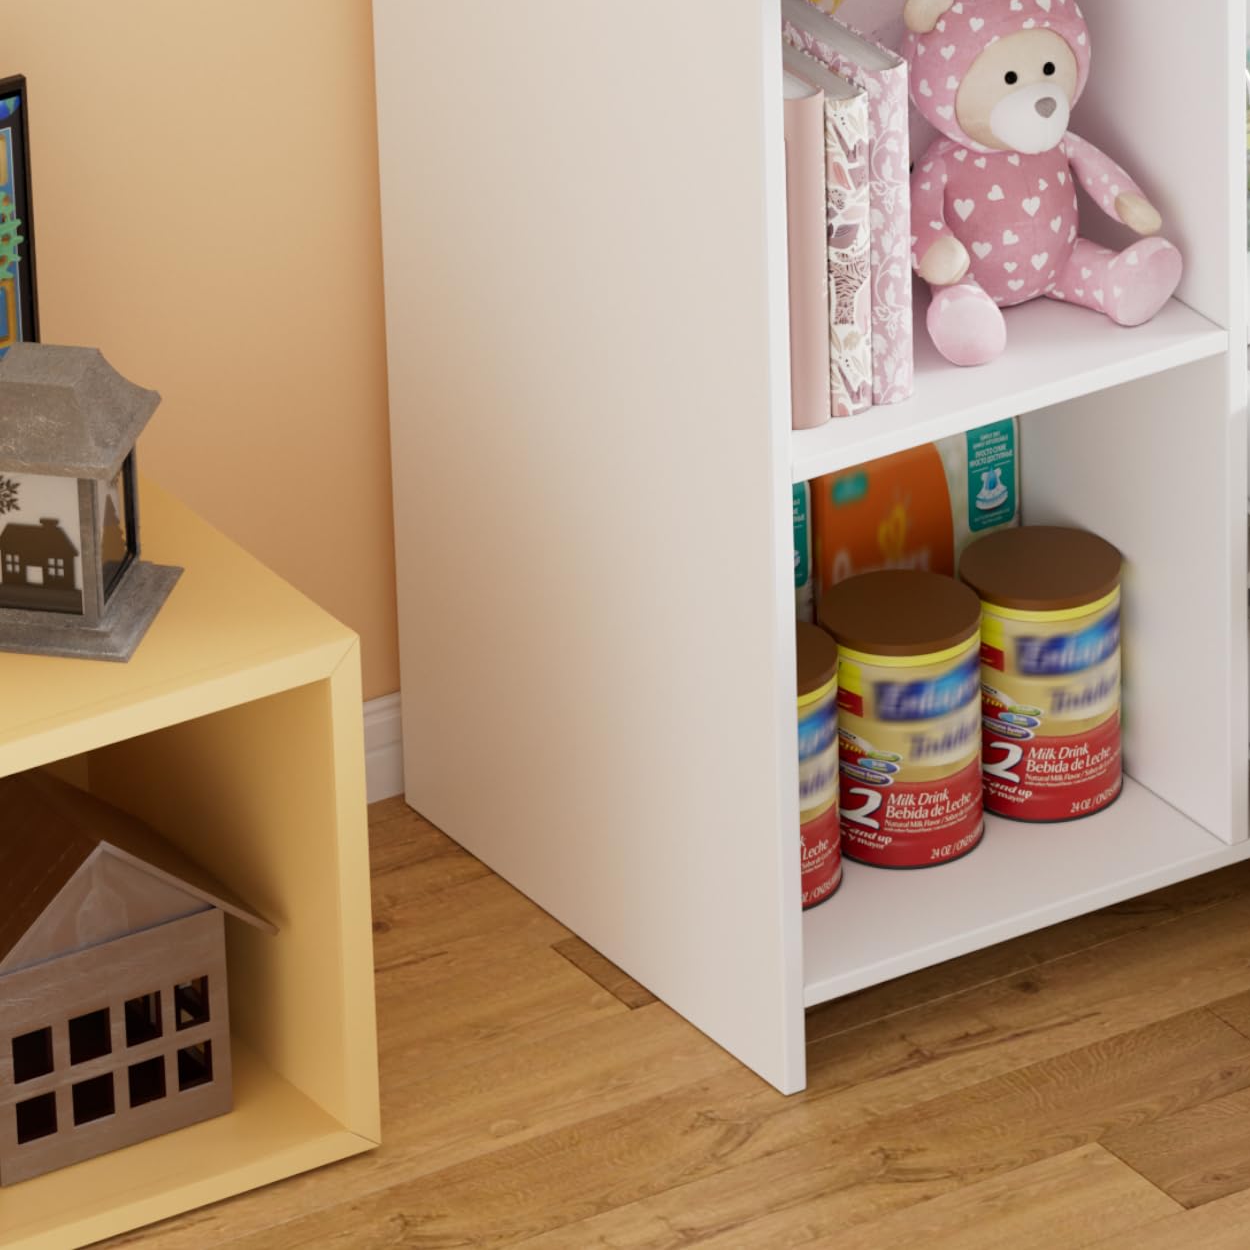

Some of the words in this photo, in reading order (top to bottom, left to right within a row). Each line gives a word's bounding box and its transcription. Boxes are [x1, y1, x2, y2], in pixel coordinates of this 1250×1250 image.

[1028, 746, 1057, 760] Milk
[1058, 742, 1089, 760] Drink
[983, 741, 1023, 783] 2
[1026, 759, 1069, 774] Bebida
[1070, 757, 1085, 771] de
[1085, 746, 1111, 768] Leche
[1024, 773, 1050, 781] Natural
[1050, 773, 1064, 782] Milk
[887, 792, 916, 806] Milk
[918, 787, 949, 806] Drink
[997, 791, 1025, 804] mayor
[1018, 789, 1033, 799] up
[840, 787, 882, 830] 2
[886, 805, 929, 819] Bebida
[930, 803, 945, 817] de
[945, 792, 972, 814] Leche
[1070, 801, 1080, 813] 24
[1080, 798, 1092, 810] OZ
[884, 819, 910, 828] Natural
[910, 819, 924, 828] Milk
[857, 837, 885, 850] mayor
[877, 835, 893, 845] up
[803, 838, 829, 860] Leche
[930, 847, 940, 860] 24
[940, 844, 953, 857] OZ
